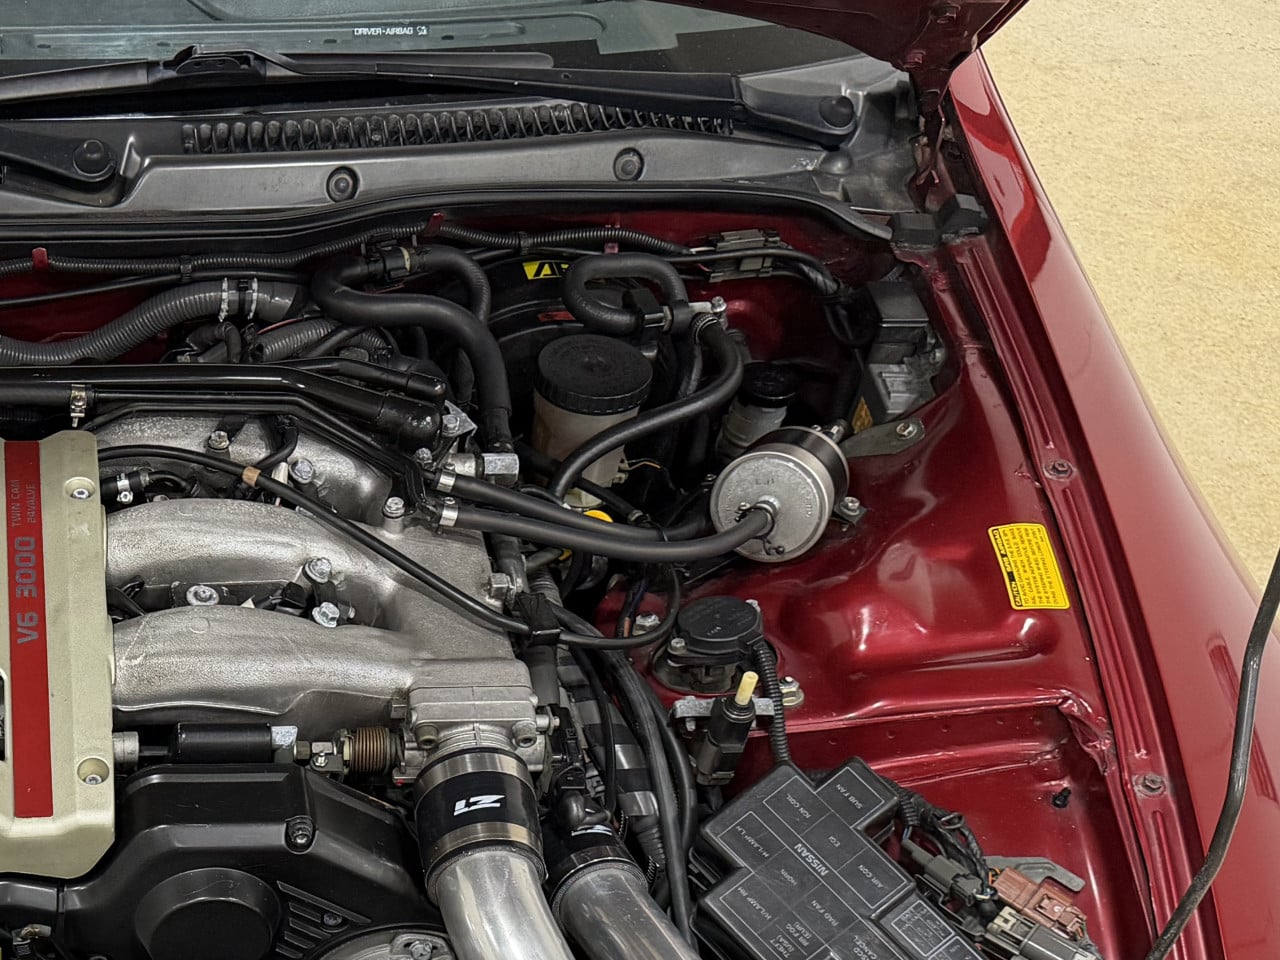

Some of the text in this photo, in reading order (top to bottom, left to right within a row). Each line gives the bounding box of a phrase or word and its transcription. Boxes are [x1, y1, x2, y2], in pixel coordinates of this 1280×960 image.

[11, 503, 22, 527] TWIN
[15, 536, 38, 644] V6 3000
[784, 793, 800, 809] COIL
[835, 782, 863, 810] SUB FAN
[735, 824, 770, 858] H/LAMP LH
[793, 841, 829, 877] NISSAN
[779, 868, 798, 887] HORN
[857, 863, 884, 890] AIR CON
[746, 894, 772, 921] H/LAMP
[810, 899, 826, 914] FAN
[769, 936, 791, 958] THEFT
[851, 934, 879, 960] CANCEL
